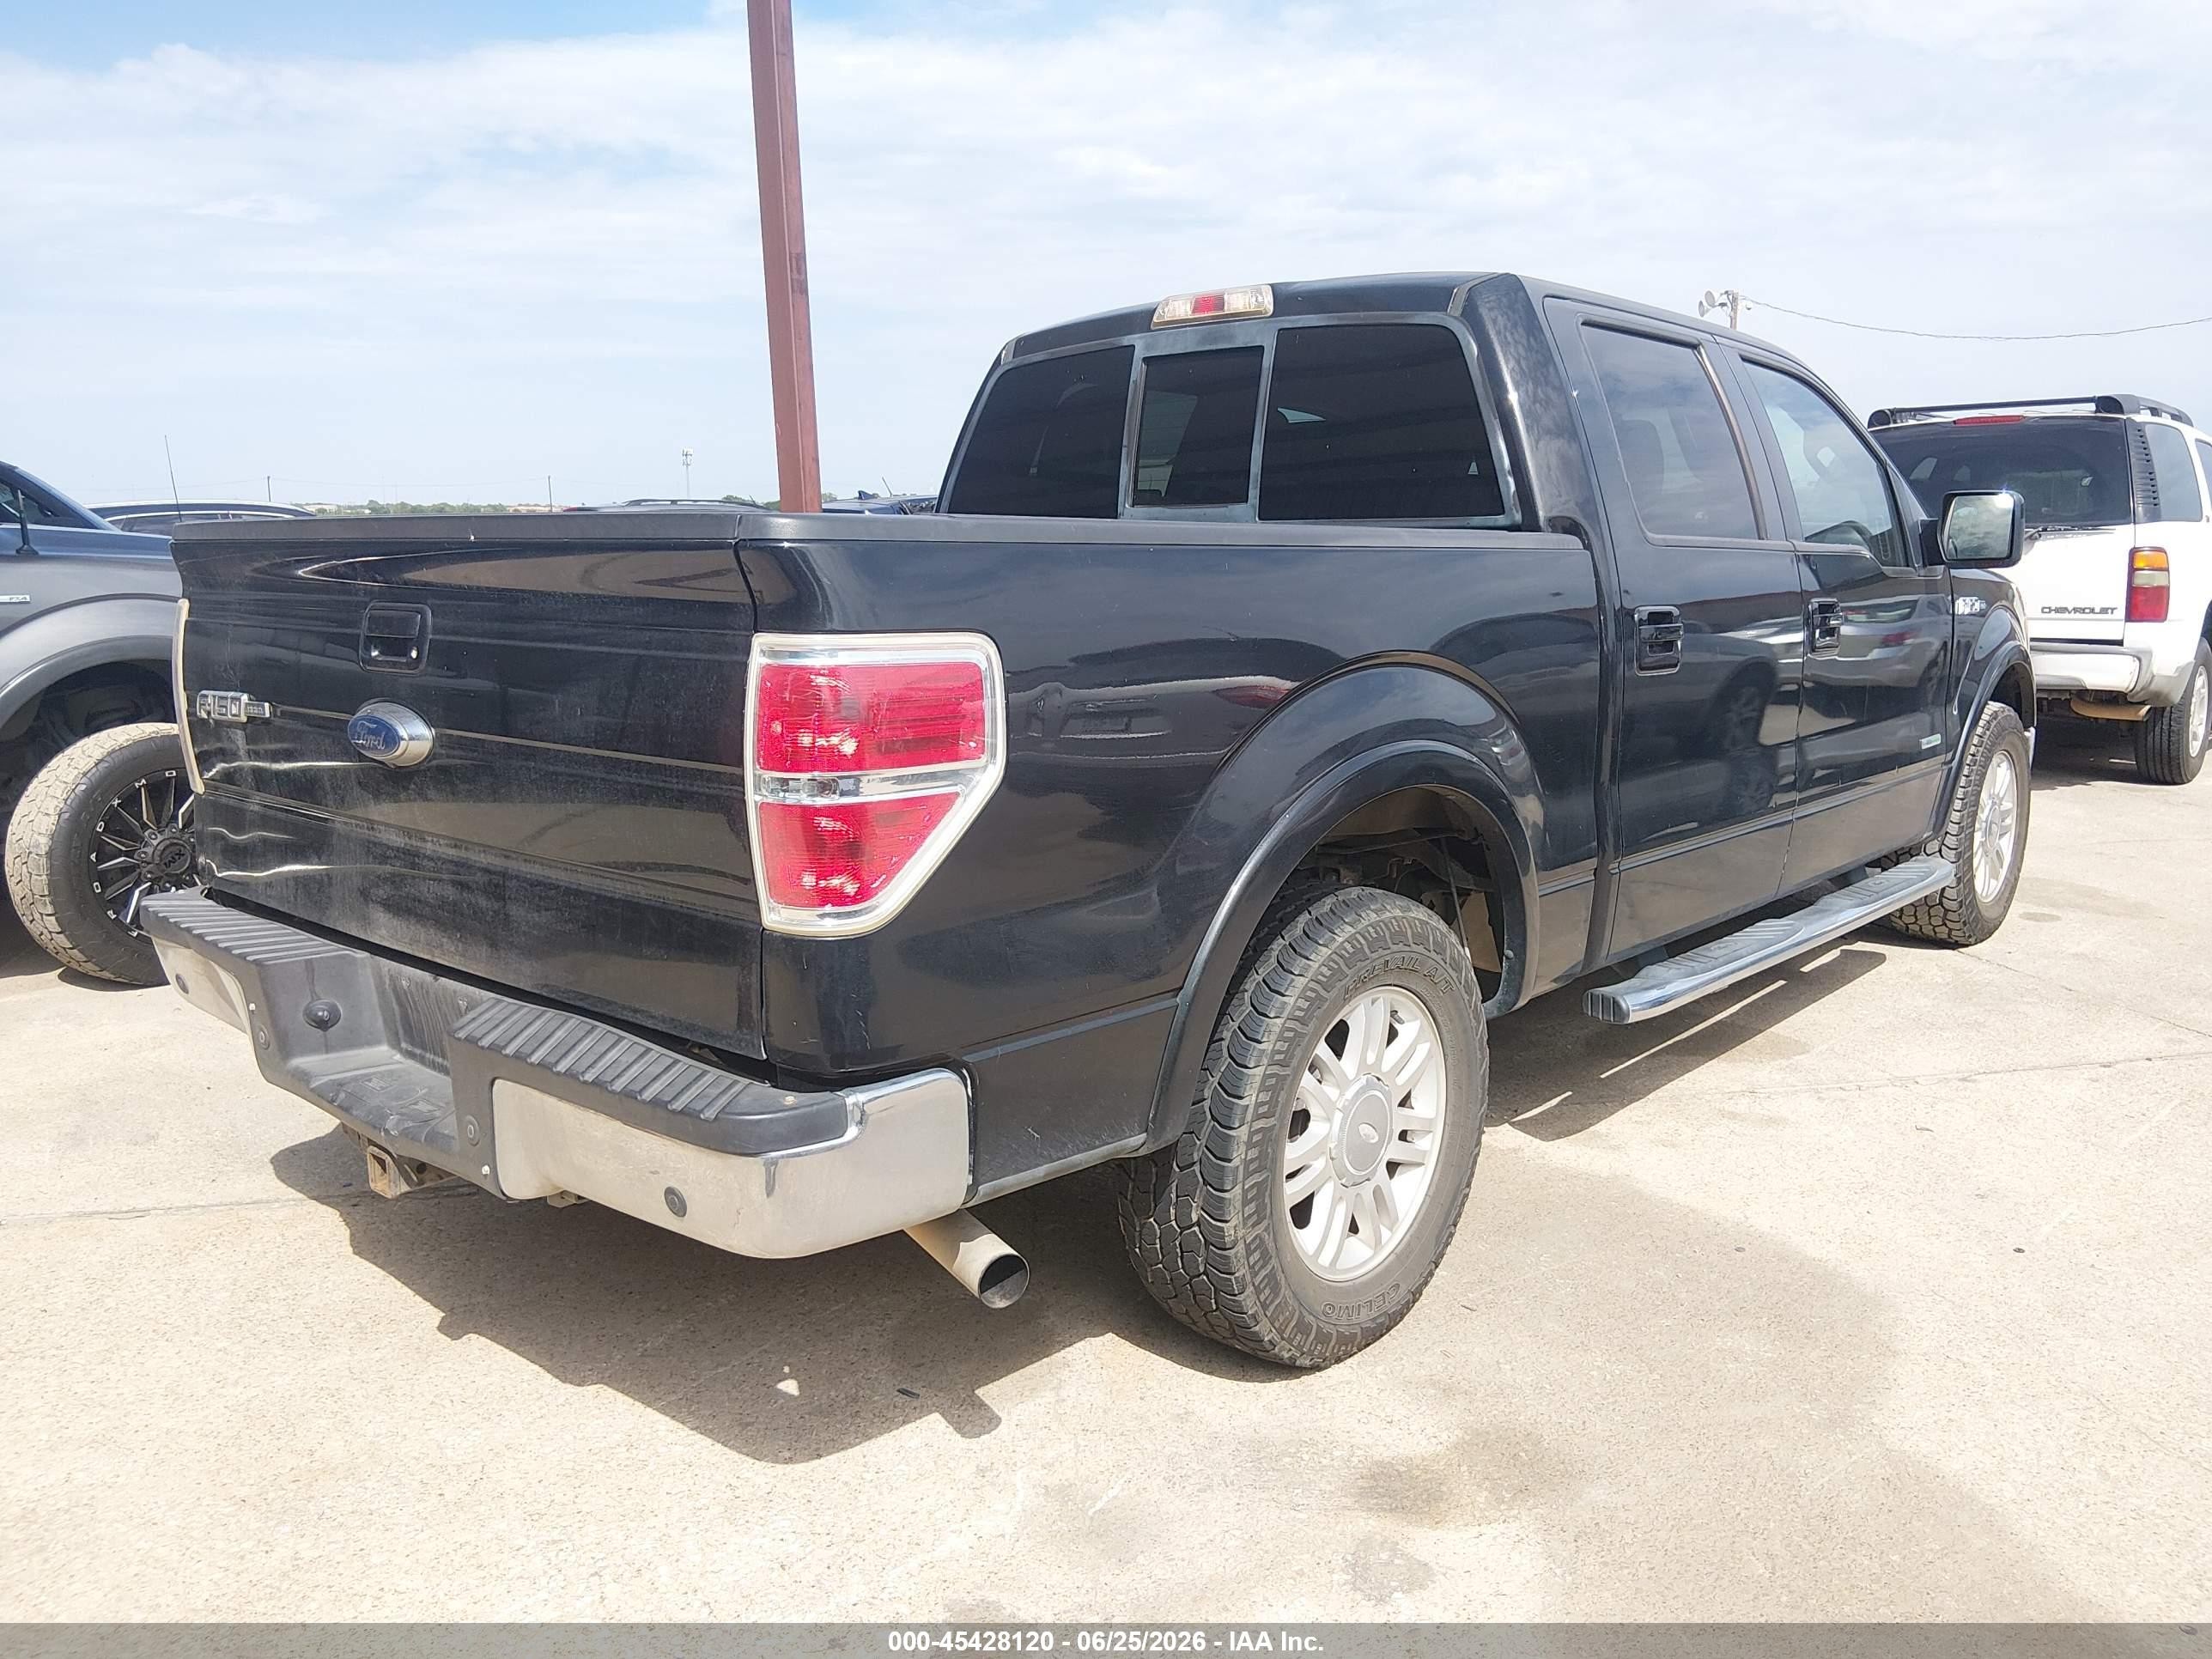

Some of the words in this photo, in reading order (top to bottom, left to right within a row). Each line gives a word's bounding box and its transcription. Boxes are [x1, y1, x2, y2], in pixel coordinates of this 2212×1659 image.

[2040, 606, 2118, 615] CHEVROLET
[350, 720, 386, 750] Ford
[1344, 955, 1421, 1001] PREVAIL
[1322, 1283, 1401, 1320] CELIMO
